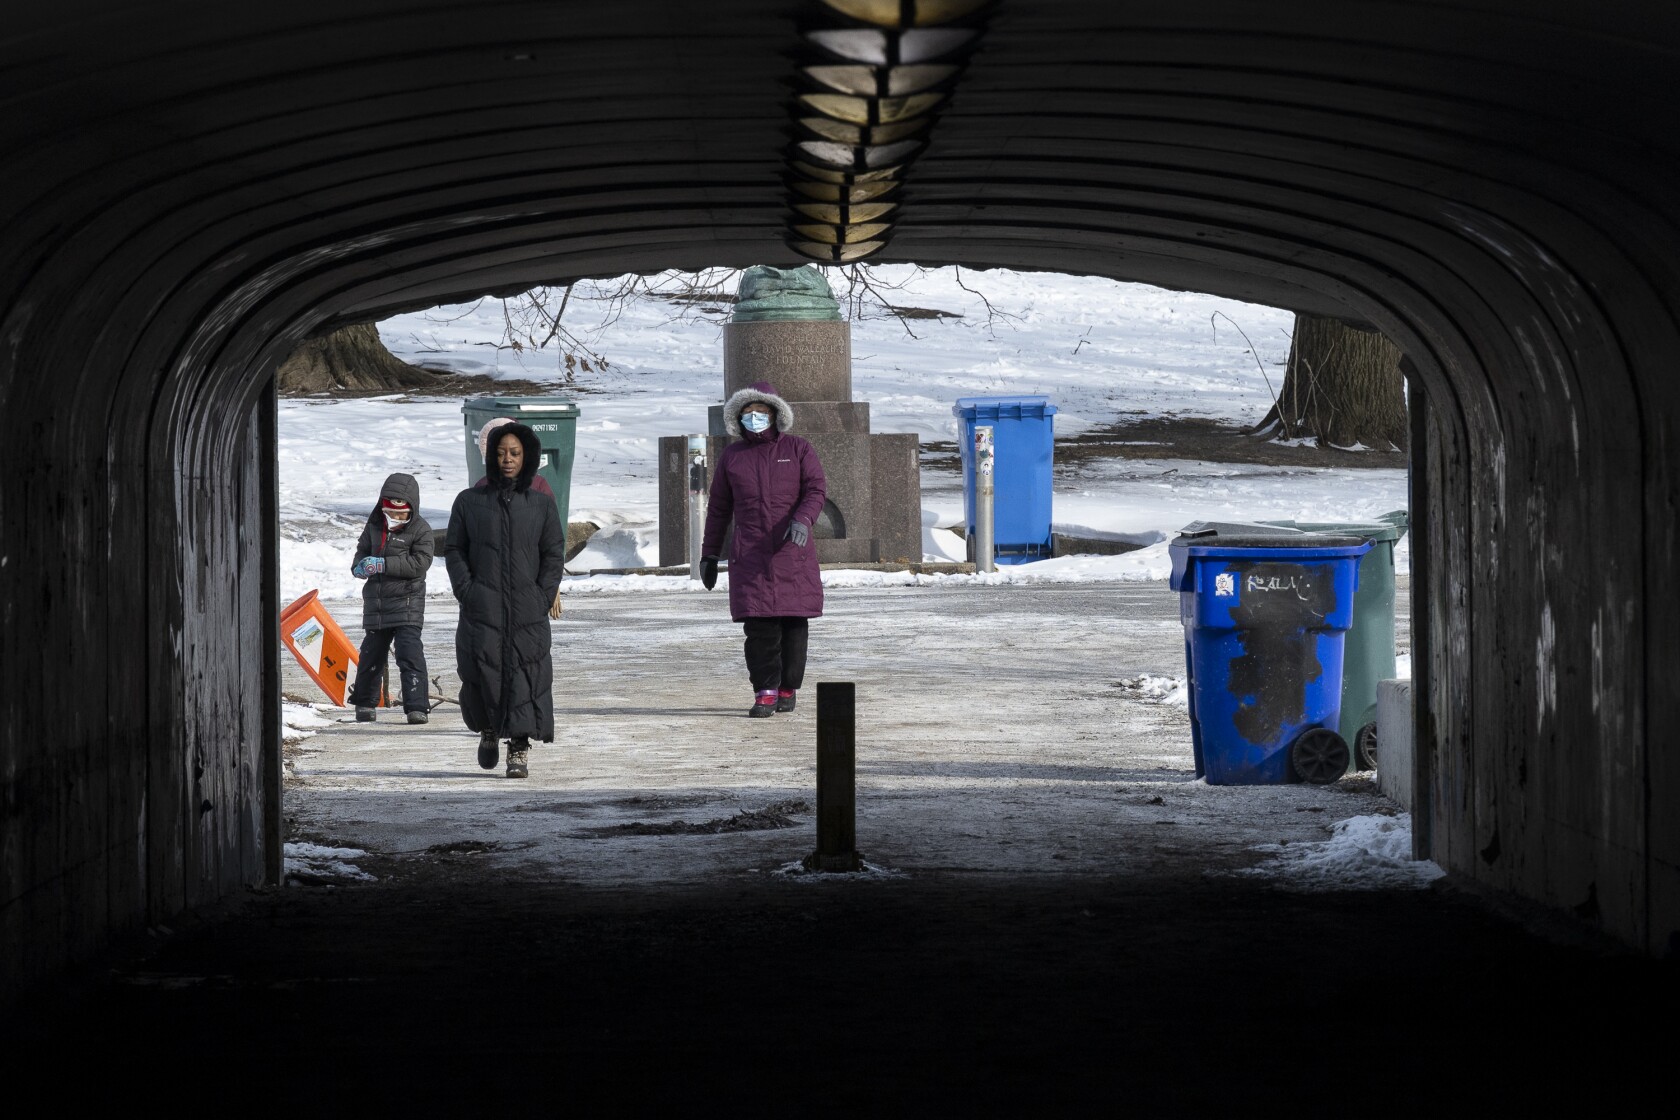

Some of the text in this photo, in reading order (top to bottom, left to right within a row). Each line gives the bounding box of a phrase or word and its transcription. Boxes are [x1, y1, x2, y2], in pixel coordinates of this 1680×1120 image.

[762, 344, 836, 353] DAVID WALLACH
[776, 355, 825, 364] FOUNTAIN
